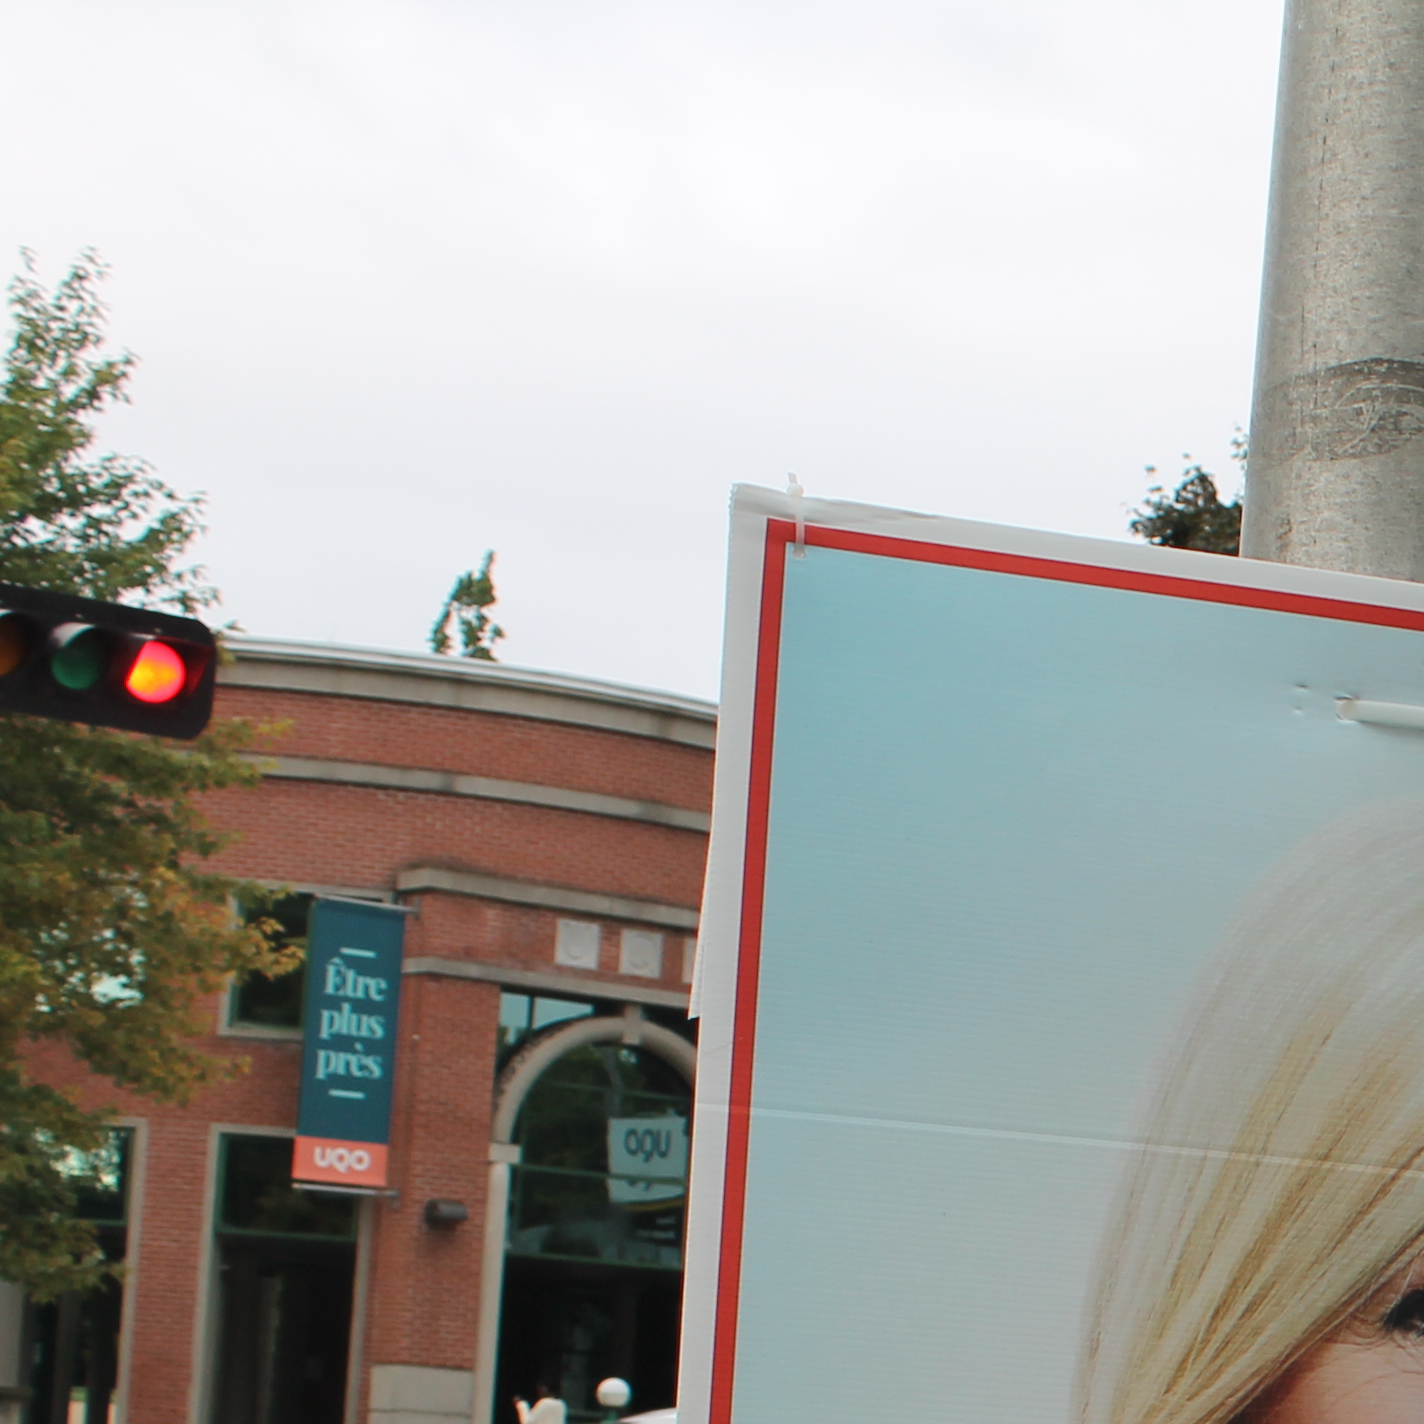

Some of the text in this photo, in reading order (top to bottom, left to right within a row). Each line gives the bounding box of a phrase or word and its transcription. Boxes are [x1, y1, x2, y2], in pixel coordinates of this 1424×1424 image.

[324, 956, 388, 1002] Être
[319, 1002, 386, 1040] plus
[315, 1042, 383, 1080] près
[313, 1145, 372, 1174] UQO
